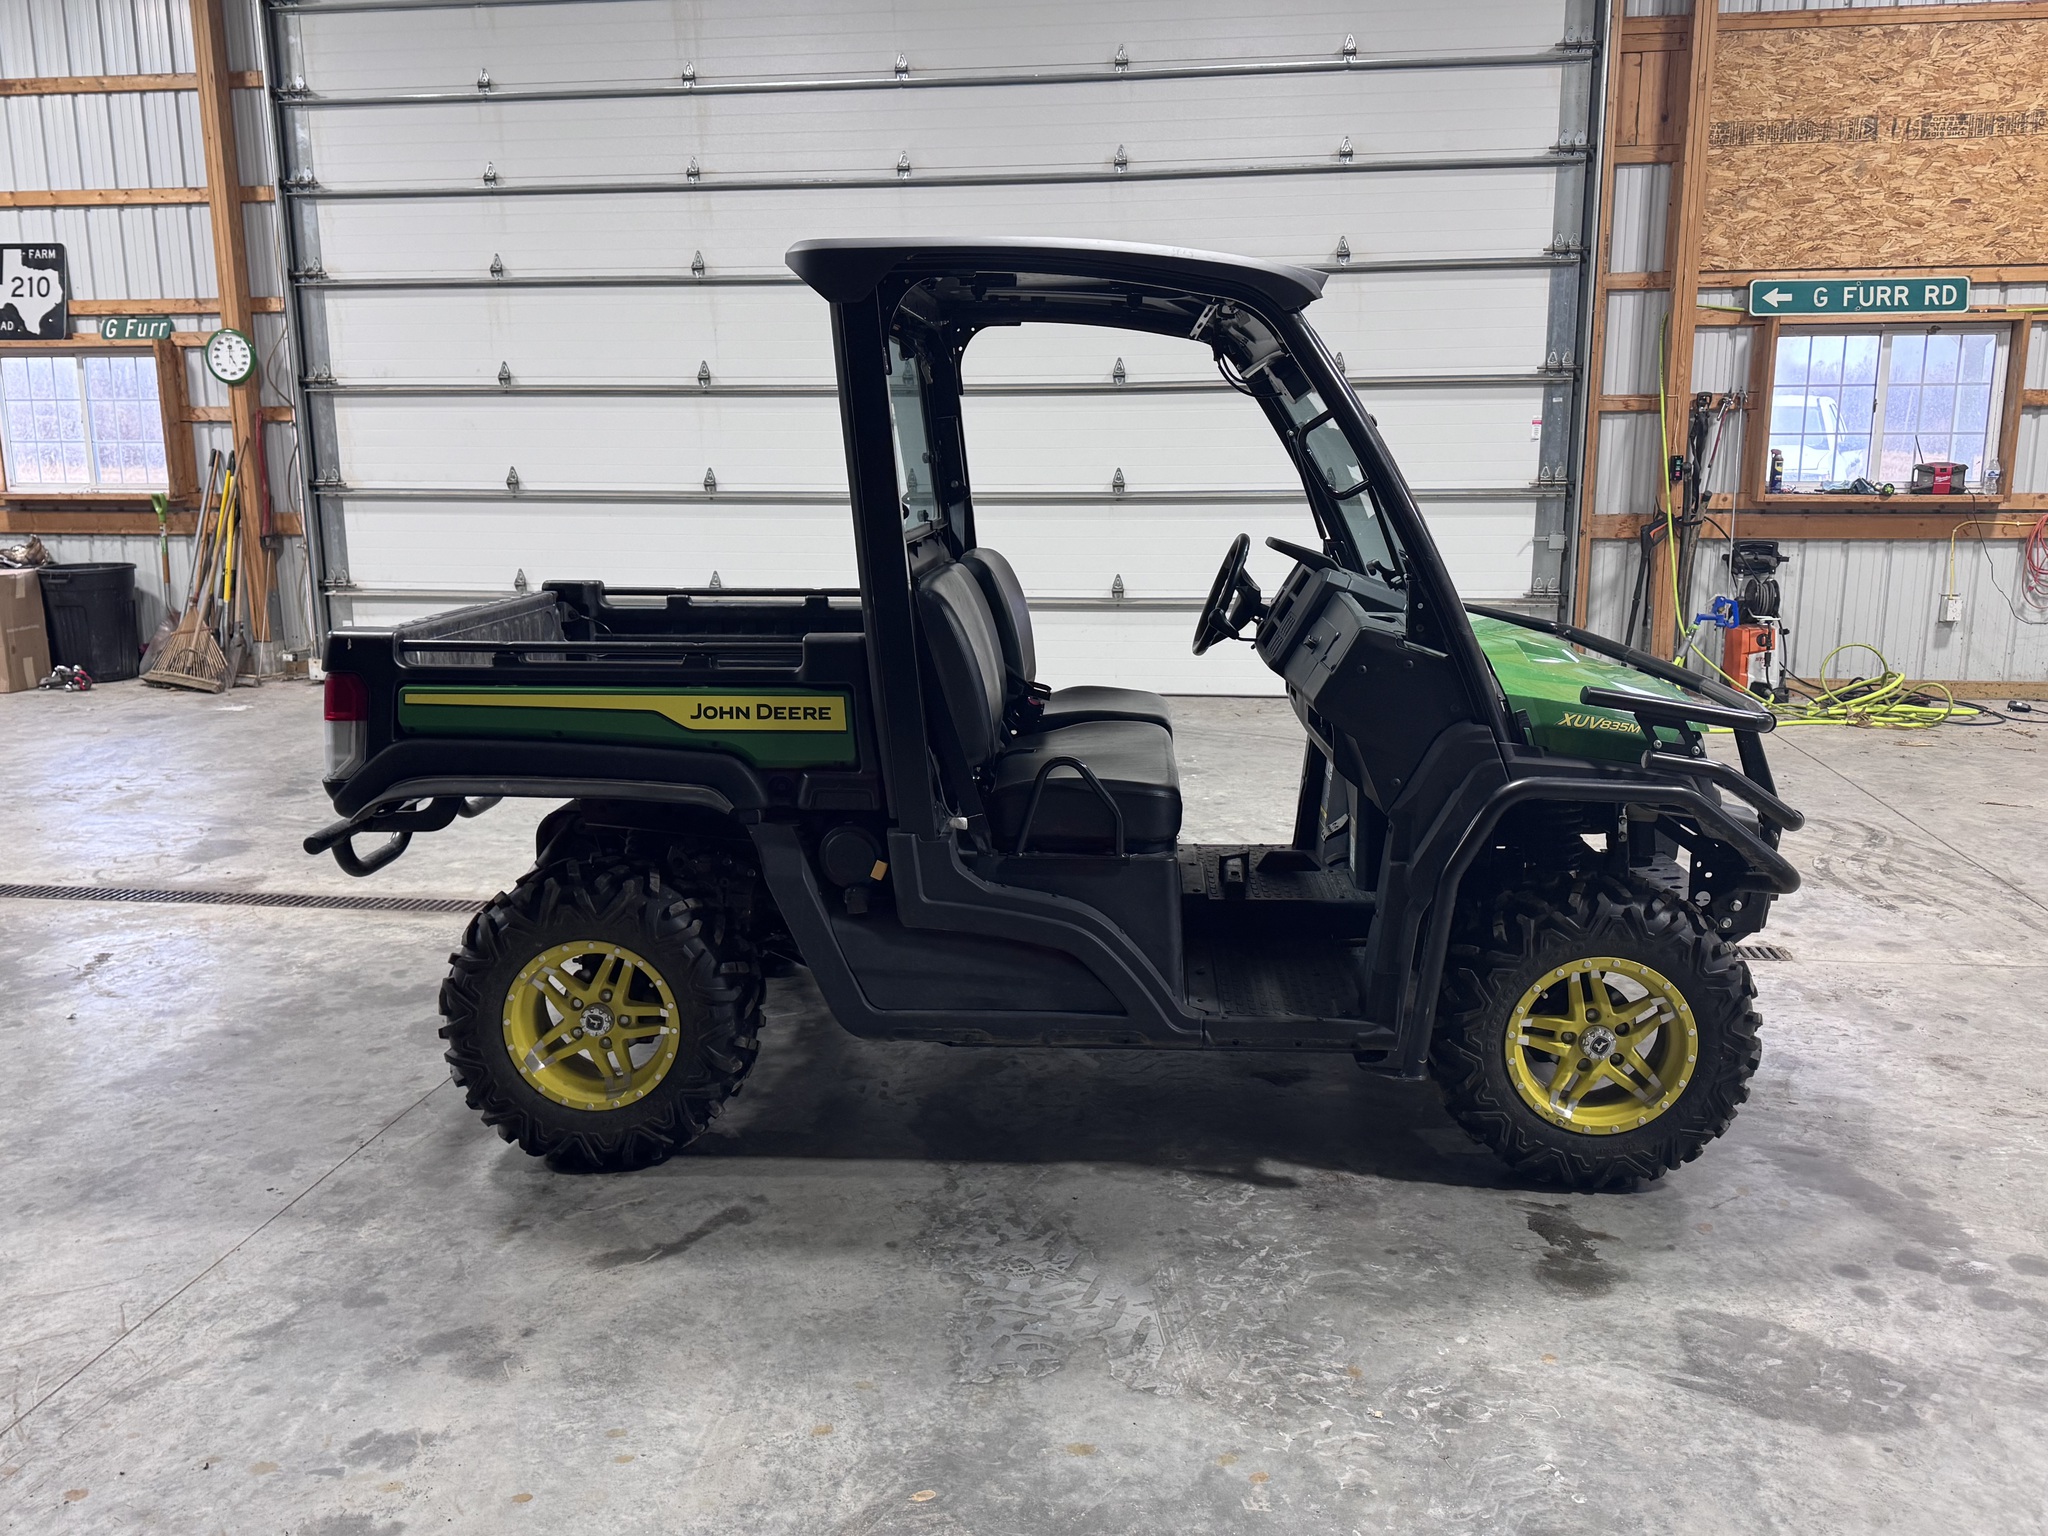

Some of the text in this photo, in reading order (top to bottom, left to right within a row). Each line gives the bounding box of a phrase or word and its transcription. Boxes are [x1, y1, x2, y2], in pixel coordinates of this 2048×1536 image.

[28, 249, 56, 259] FARM
[11, 276, 51, 298] 210
[1813, 285, 1958, 308] G FURR RD
[105, 319, 168, 338] G Furr
[690, 703, 832, 720] JOHN DEERE
